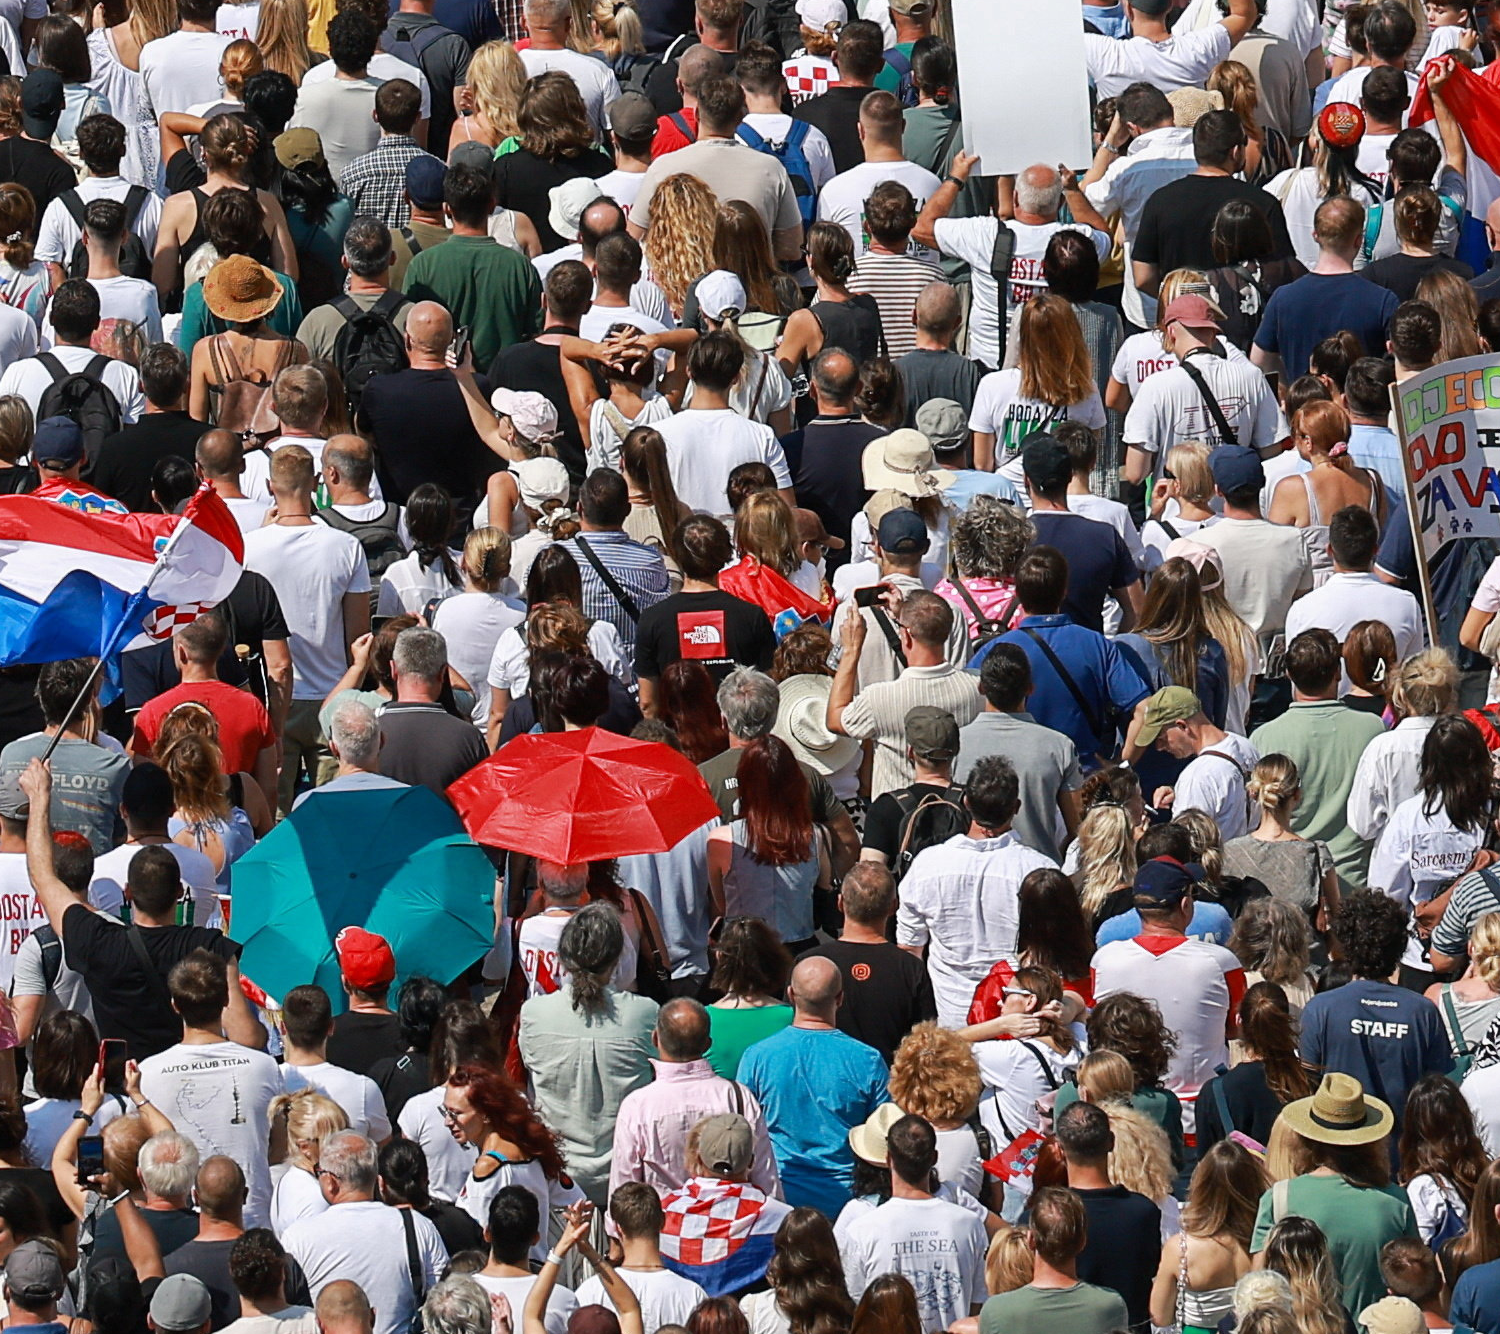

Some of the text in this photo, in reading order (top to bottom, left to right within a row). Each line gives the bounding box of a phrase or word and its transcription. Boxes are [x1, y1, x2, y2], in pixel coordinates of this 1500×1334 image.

[1405, 420, 1466, 467] OVO
[1414, 480, 1460, 533] ZA
[681, 631, 707, 639] NORTH
[1350, 1018, 1409, 1038] STAFF
[159, 1057, 251, 1075] AUTO KLUB TITAN
[890, 1238, 962, 1257] THE SEA
